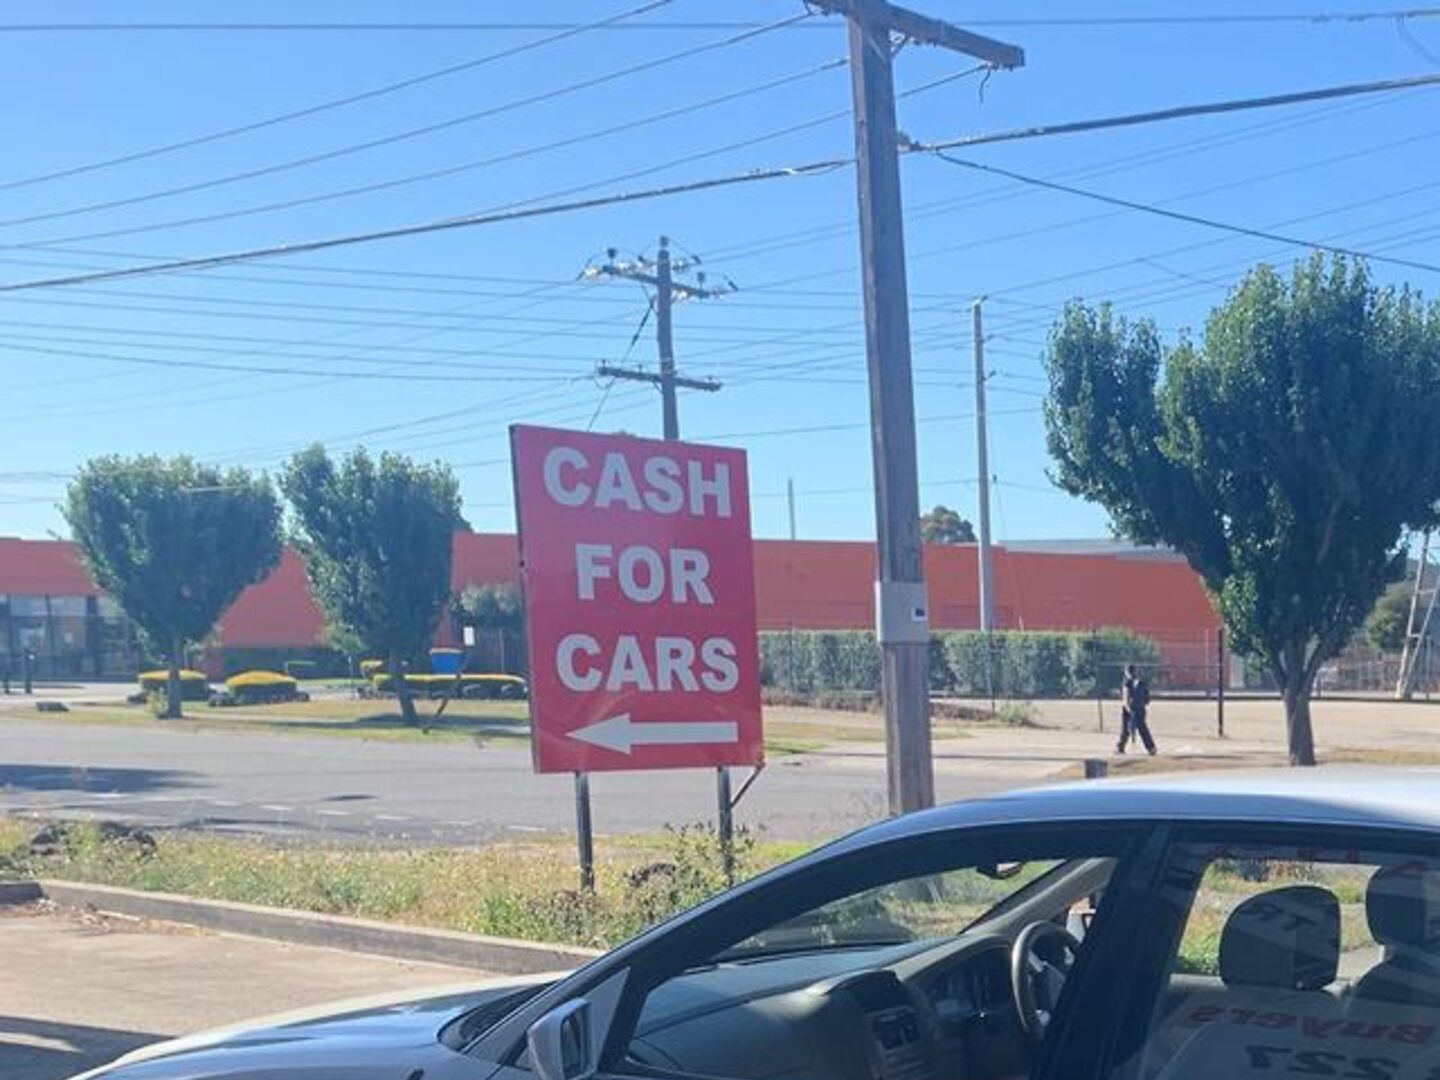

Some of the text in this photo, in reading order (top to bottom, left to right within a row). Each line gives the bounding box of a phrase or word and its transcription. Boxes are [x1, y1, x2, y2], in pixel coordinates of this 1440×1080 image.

[543, 447, 732, 518] CASH
[575, 543, 715, 604] FOR
[556, 634, 739, 693] CARS
